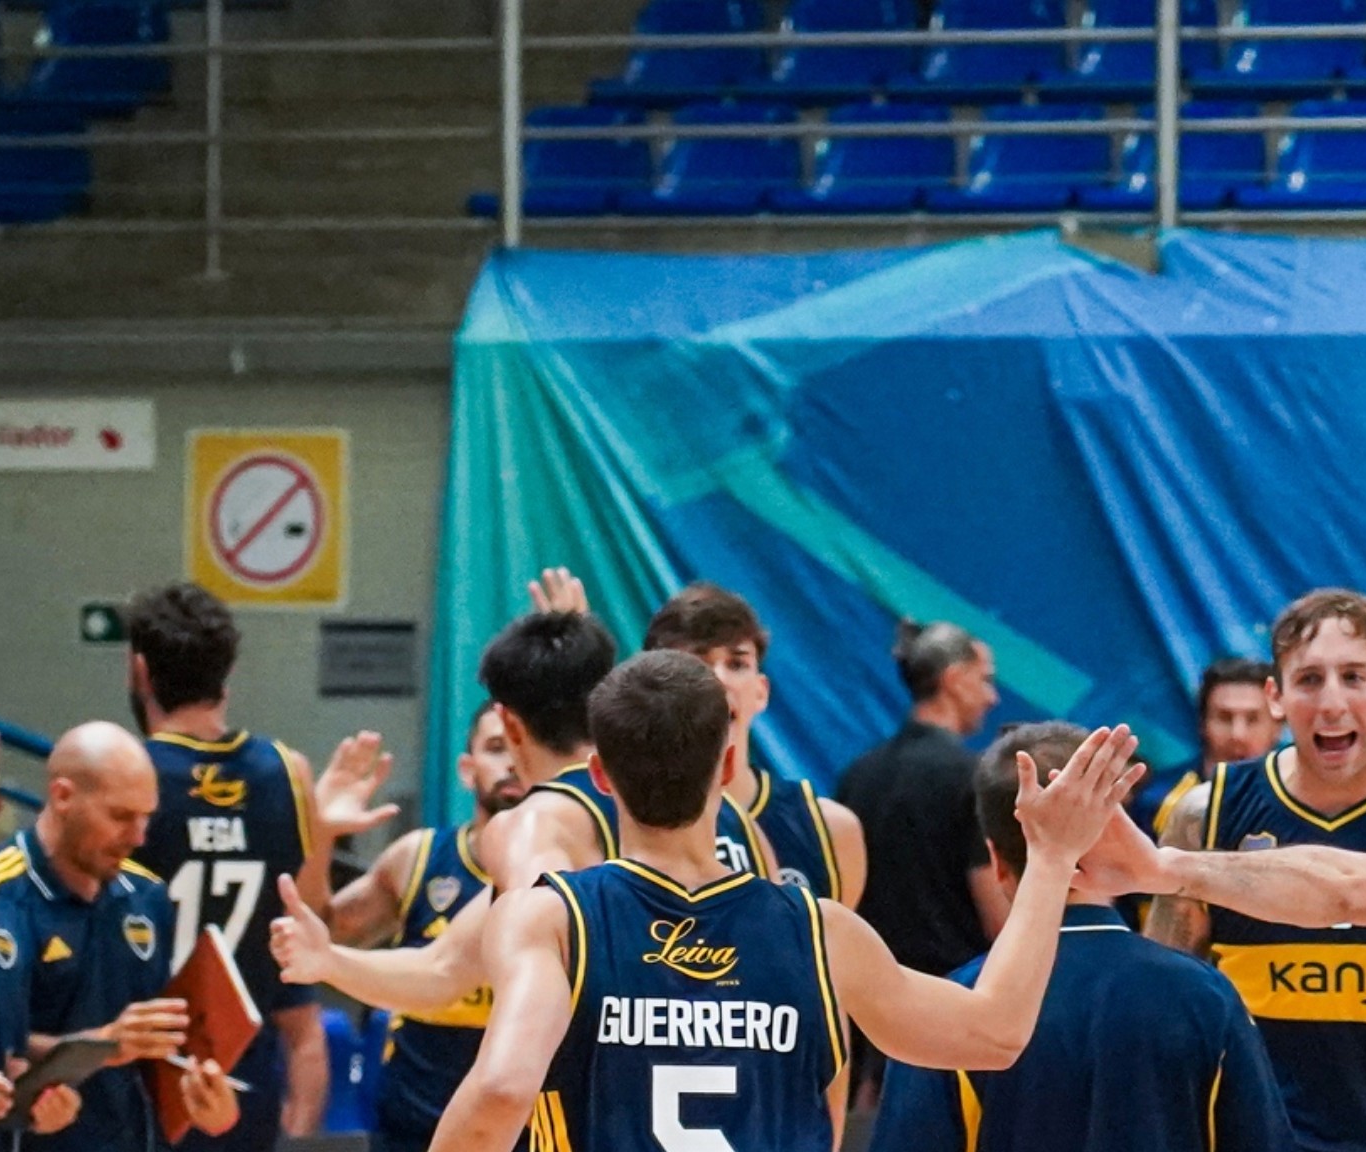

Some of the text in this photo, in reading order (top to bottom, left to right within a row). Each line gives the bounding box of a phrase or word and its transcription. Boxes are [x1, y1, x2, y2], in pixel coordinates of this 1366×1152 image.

[168, 860, 266, 978] 17
[642, 916, 739, 981] Leiva
[597, 996, 800, 1053] GUERRERO
